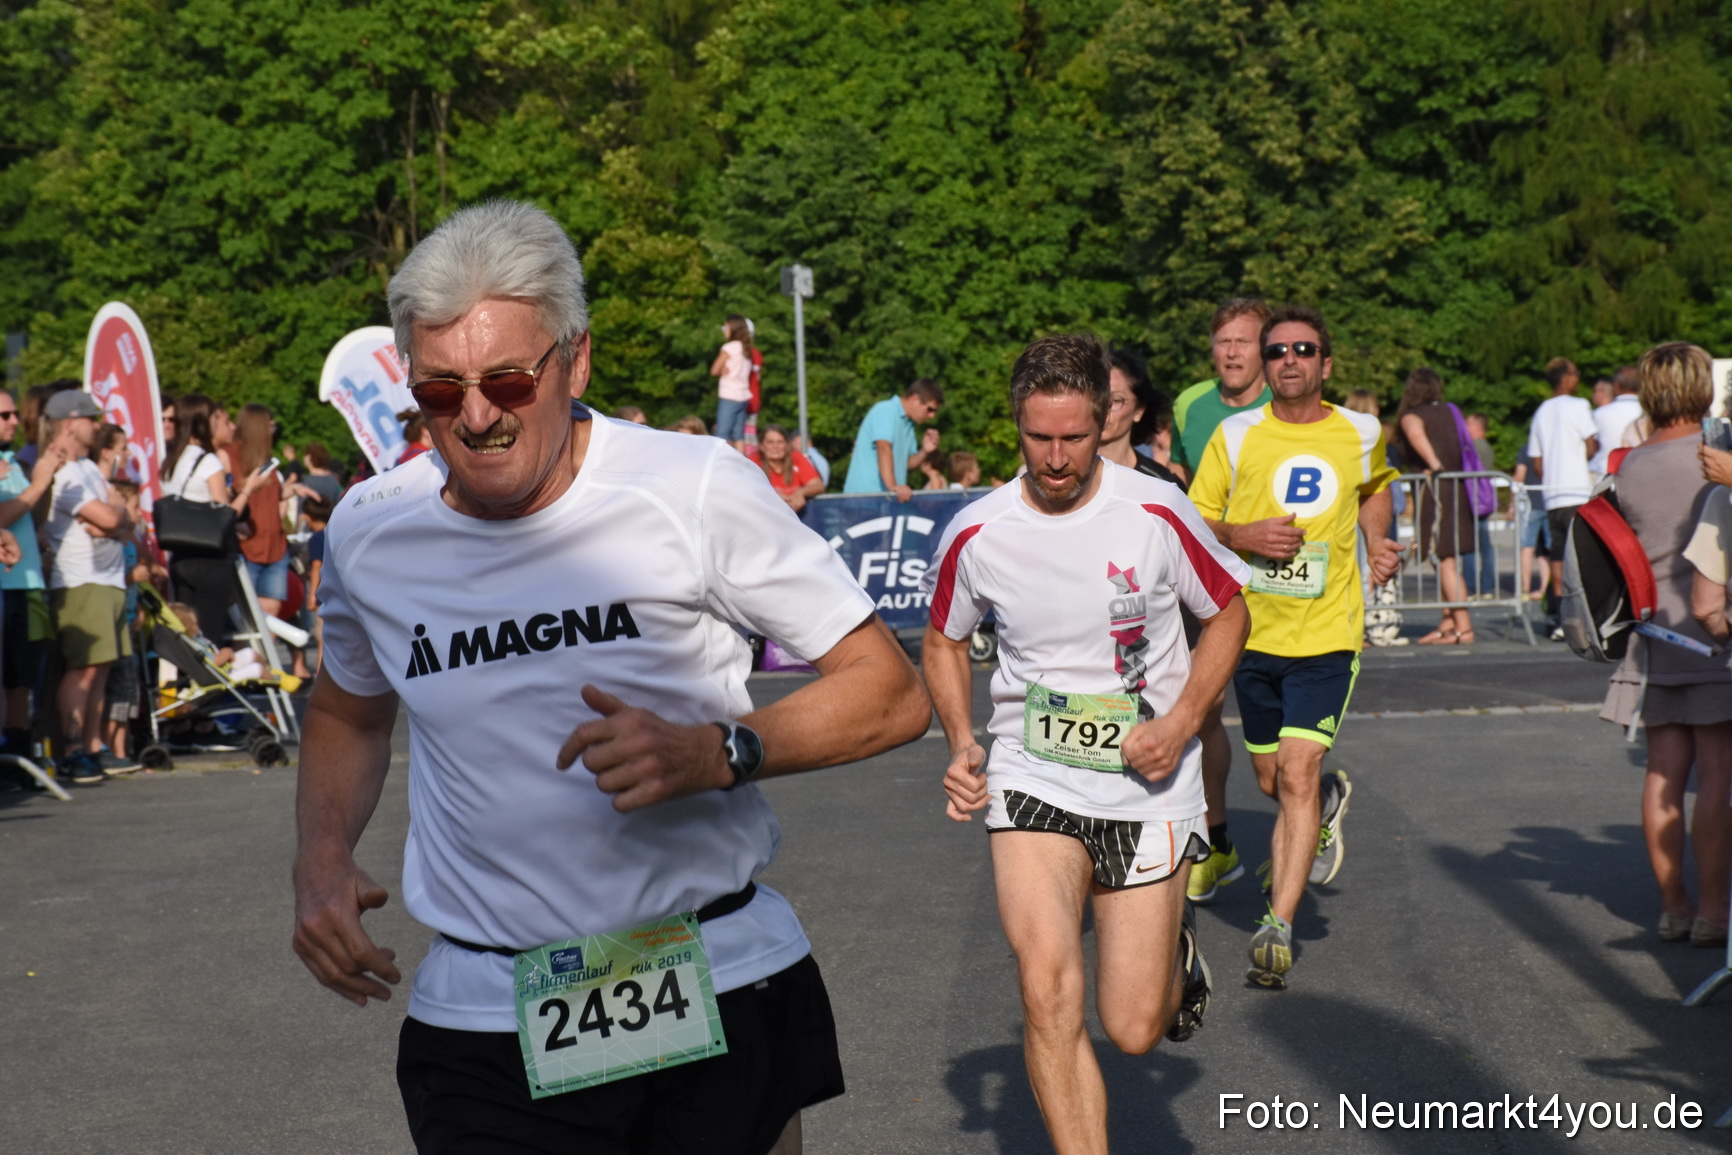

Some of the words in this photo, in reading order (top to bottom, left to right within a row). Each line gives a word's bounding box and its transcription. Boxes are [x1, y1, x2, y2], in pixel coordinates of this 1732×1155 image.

[1284, 467, 1322, 503] B
[1265, 559, 1309, 581] 354
[448, 603, 641, 670] MAGNA
[1038, 714, 1121, 750] 1792
[1054, 742, 1080, 754] Zeiser
[1083, 748, 1102, 757] Tom
[540, 960, 614, 990] firmenlauf
[657, 951, 692, 969] 2019
[538, 968, 690, 1052] 2434
